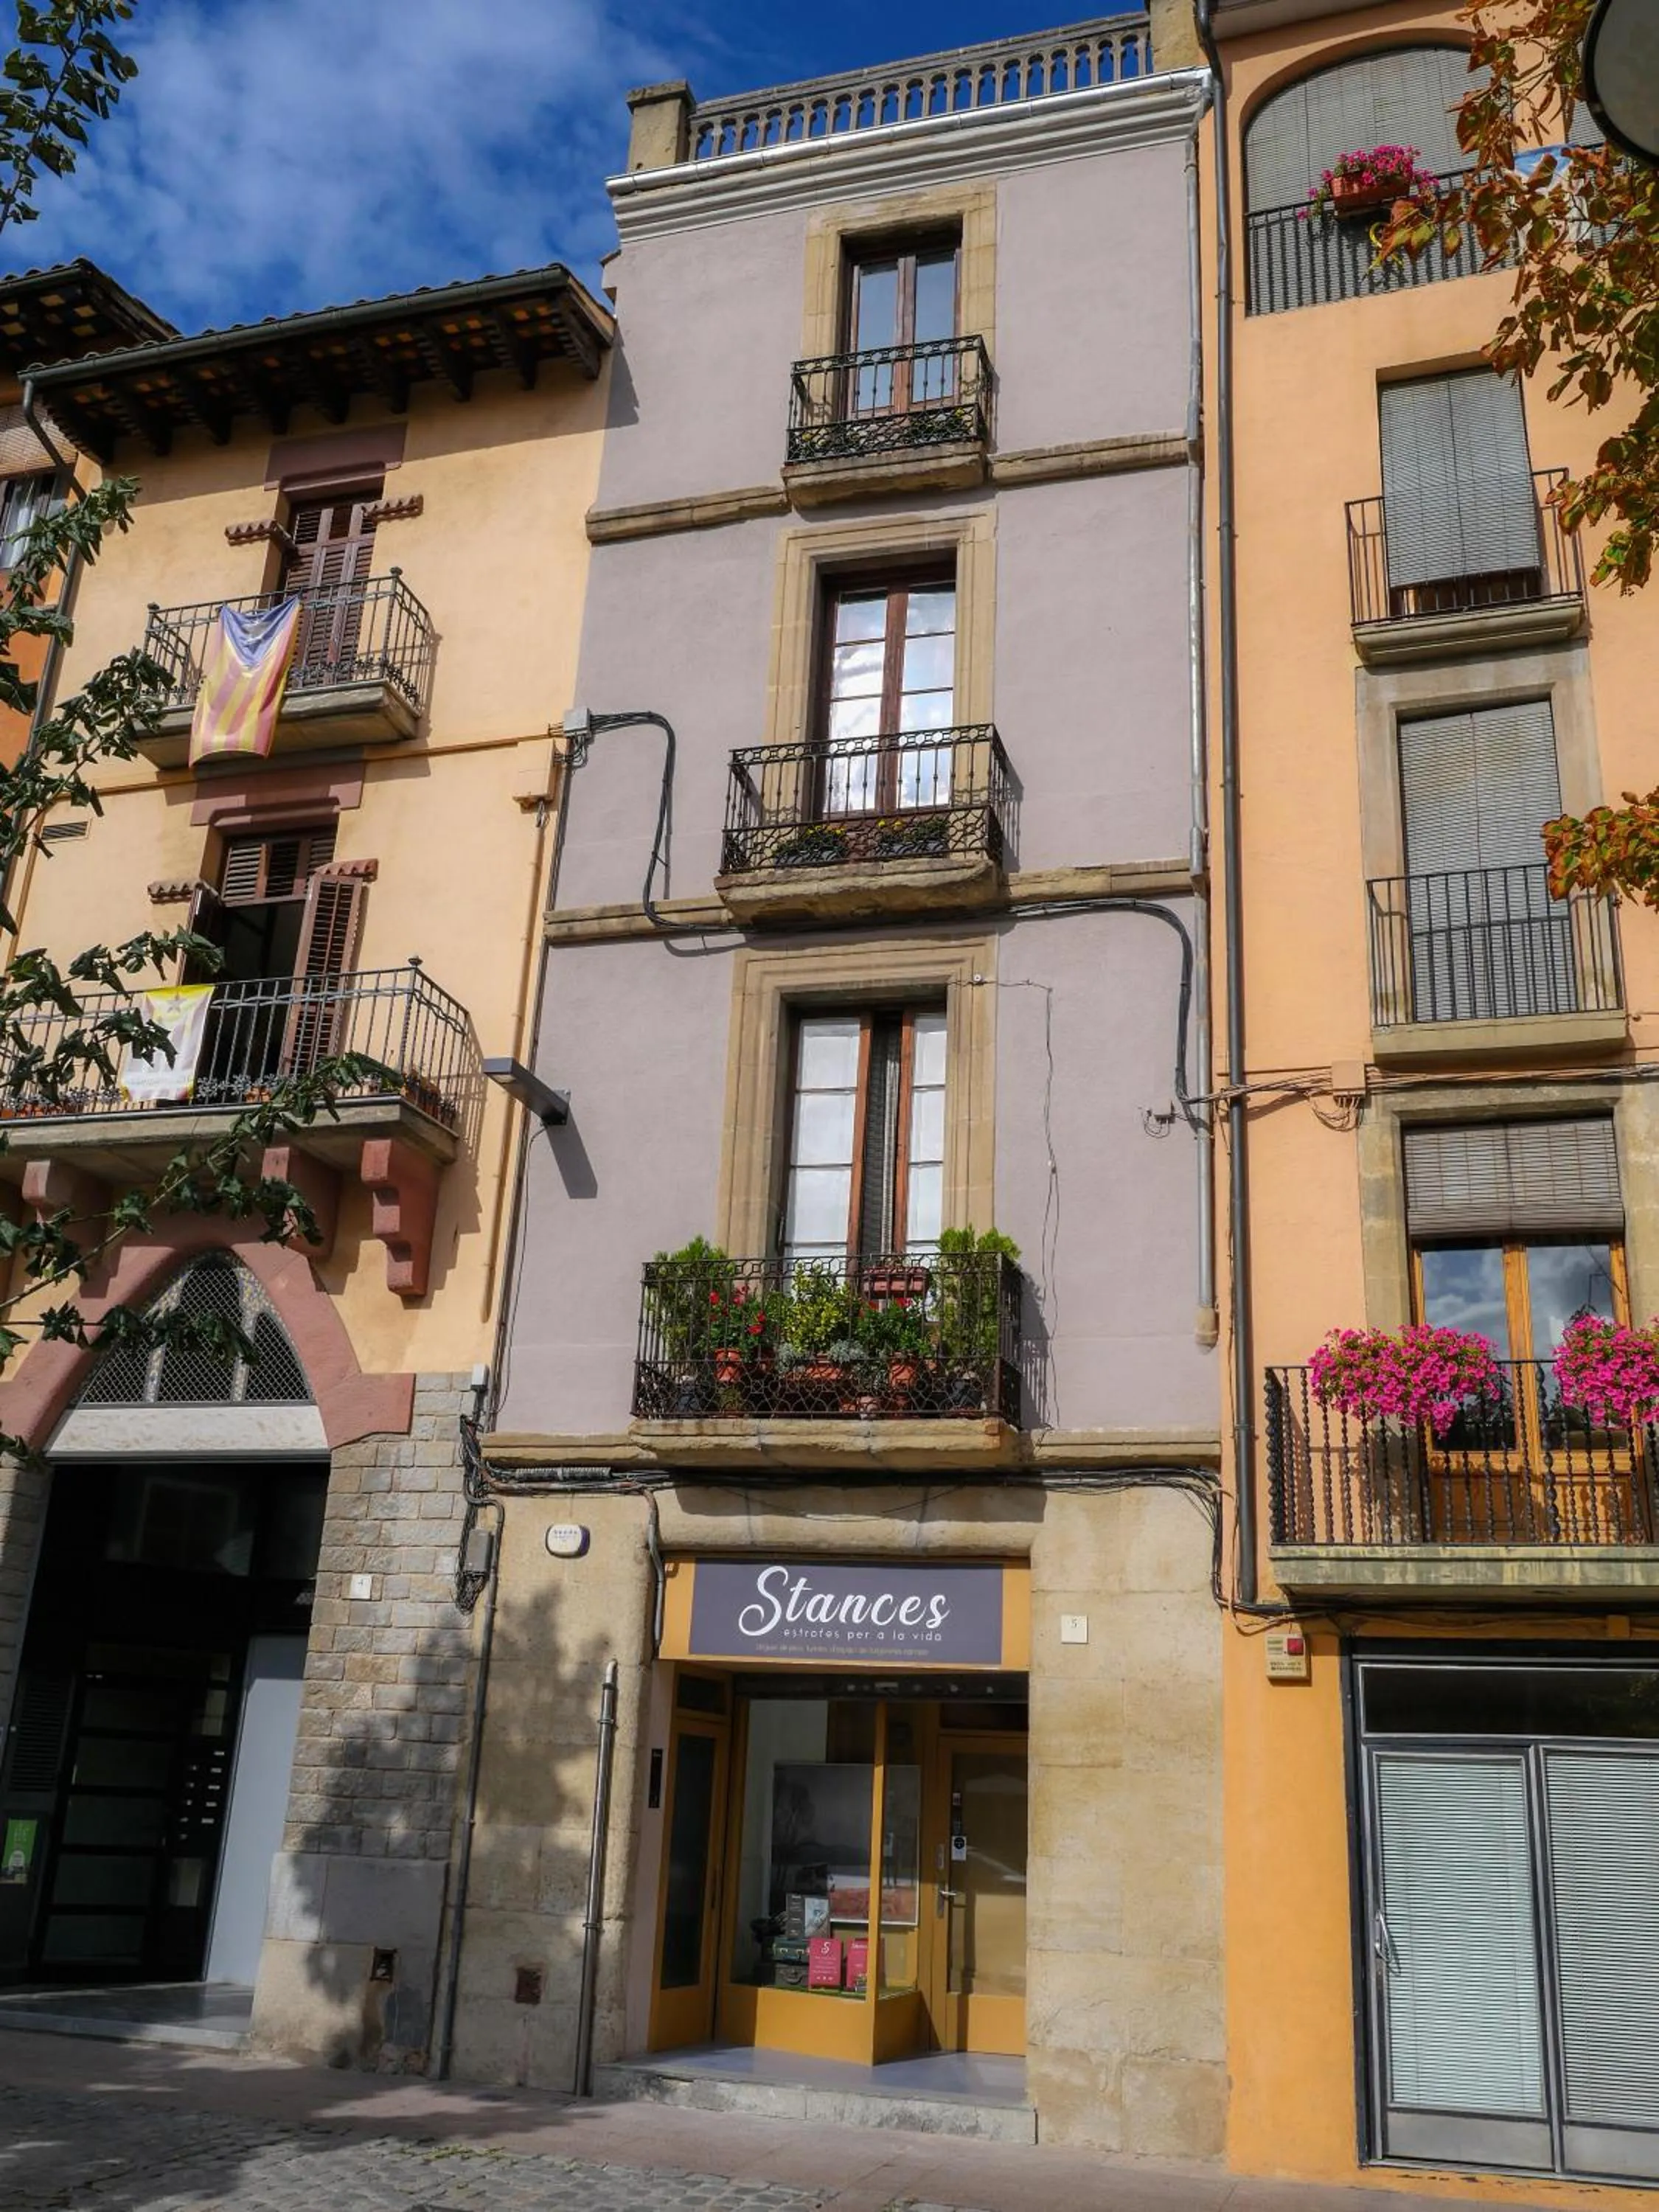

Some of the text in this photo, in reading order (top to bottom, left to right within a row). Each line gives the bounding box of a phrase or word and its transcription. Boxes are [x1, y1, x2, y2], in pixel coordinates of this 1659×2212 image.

[739, 1565, 950, 1636] Stances
[847, 1631, 869, 1642] per
[877, 1632, 885, 1641] a
[893, 1630, 905, 1641] la
[912, 1631, 942, 1642] vida
